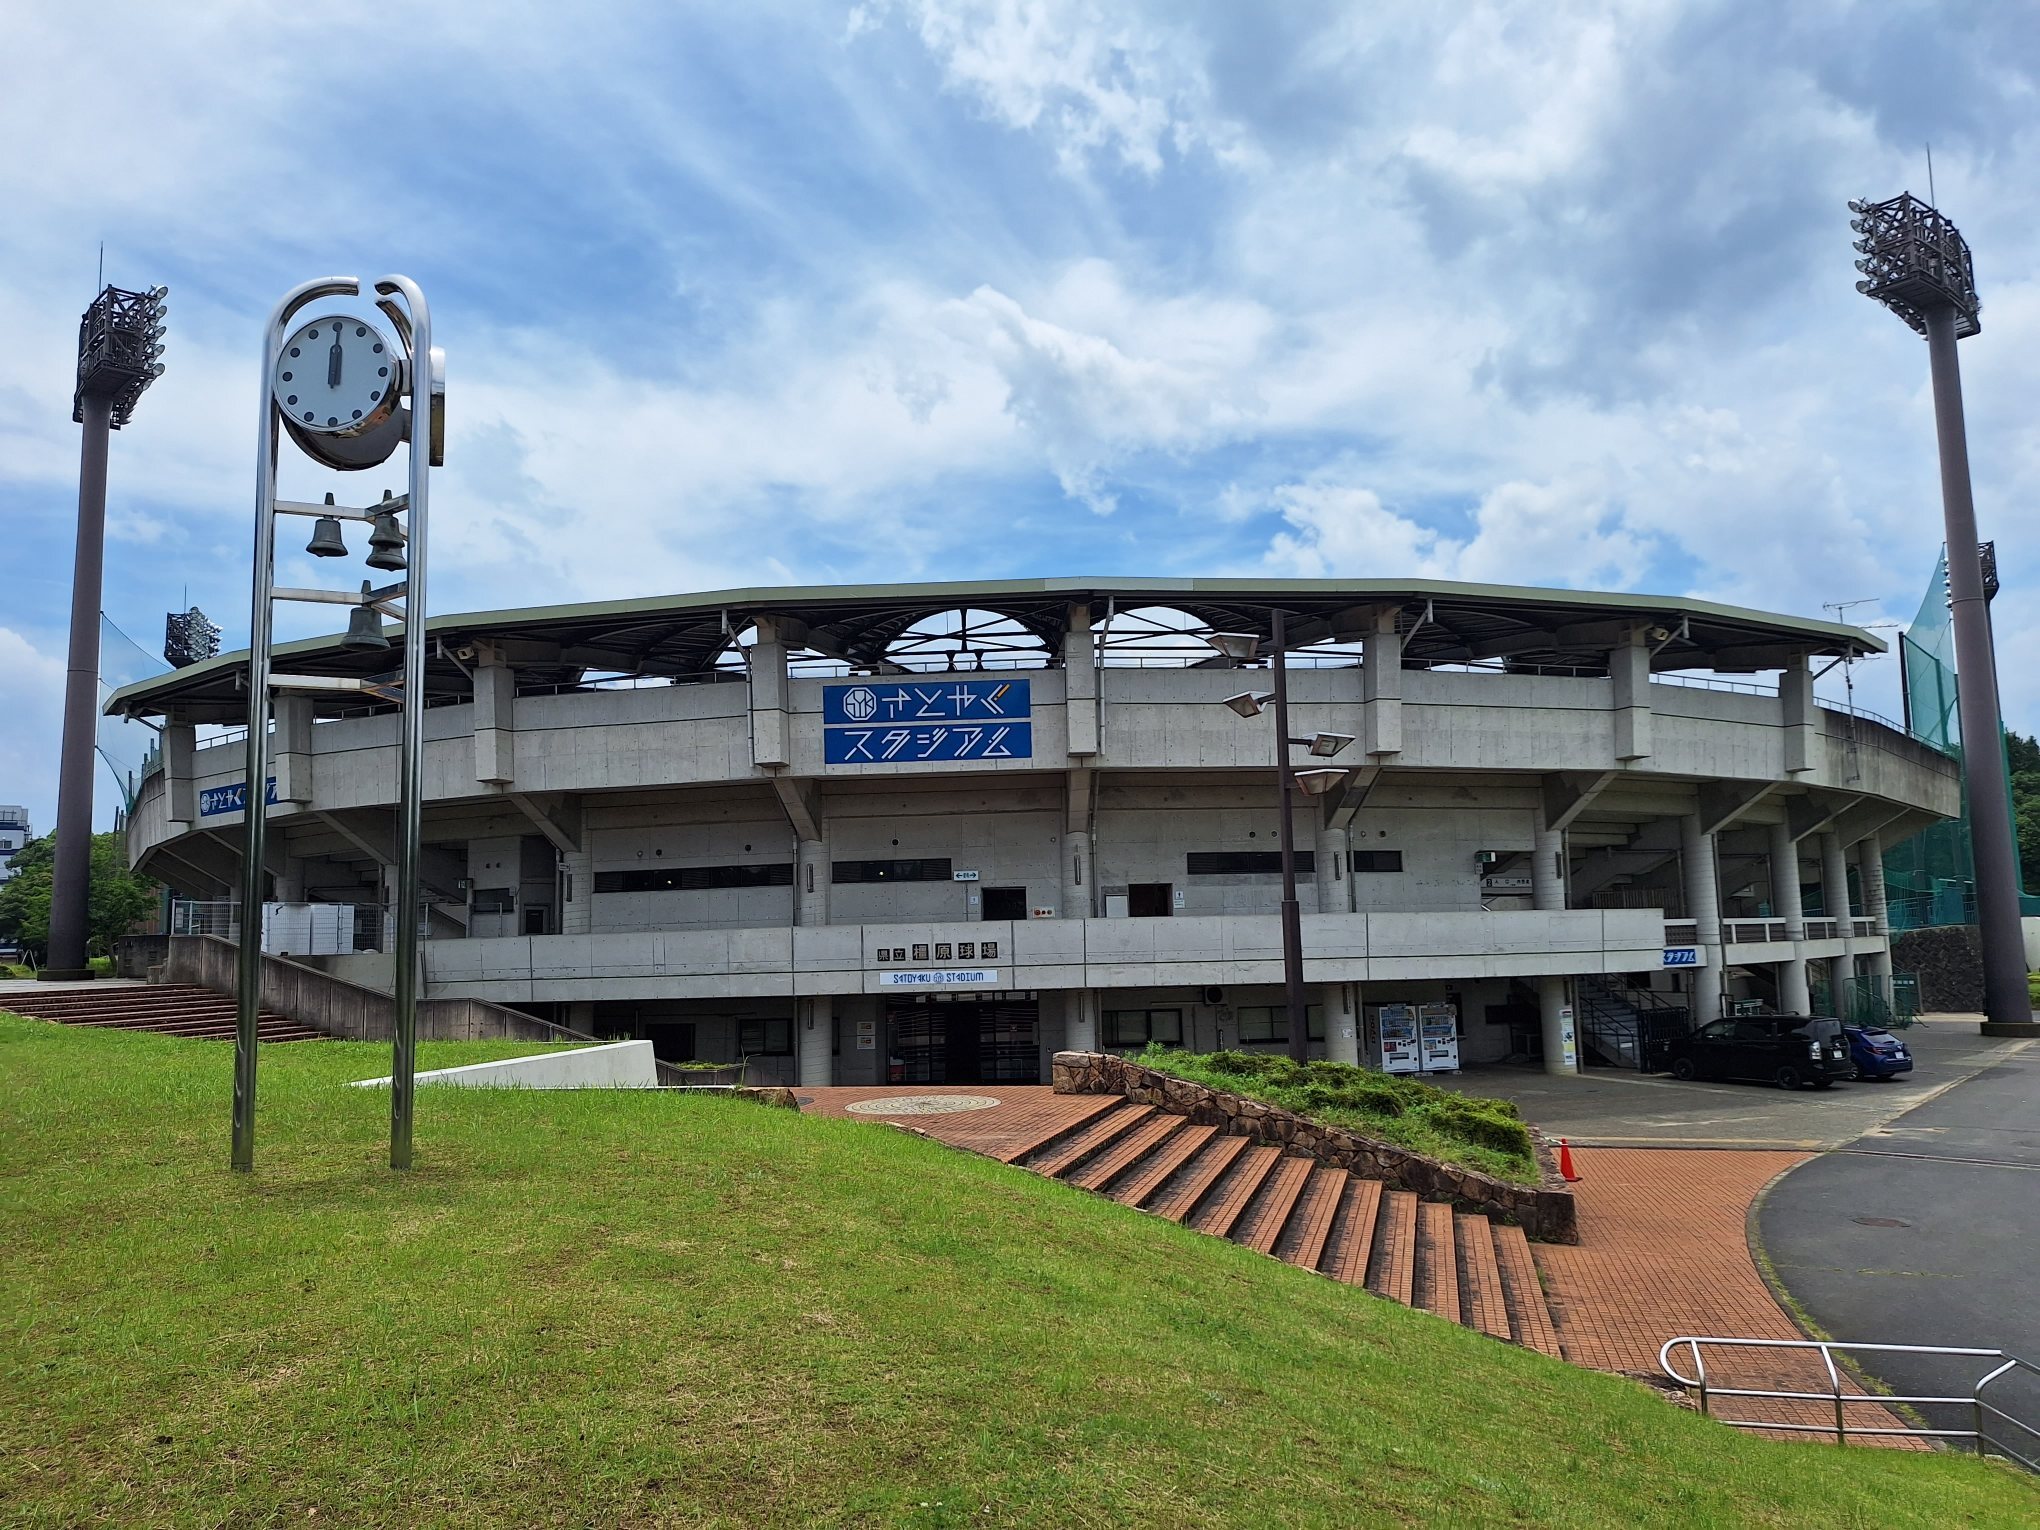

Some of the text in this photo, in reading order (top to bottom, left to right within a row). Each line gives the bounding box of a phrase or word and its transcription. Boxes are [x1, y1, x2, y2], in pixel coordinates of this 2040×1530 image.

[844, 727, 1012, 760] スタジアム
[893, 972, 984, 984] SATOYAKU STADIUM
